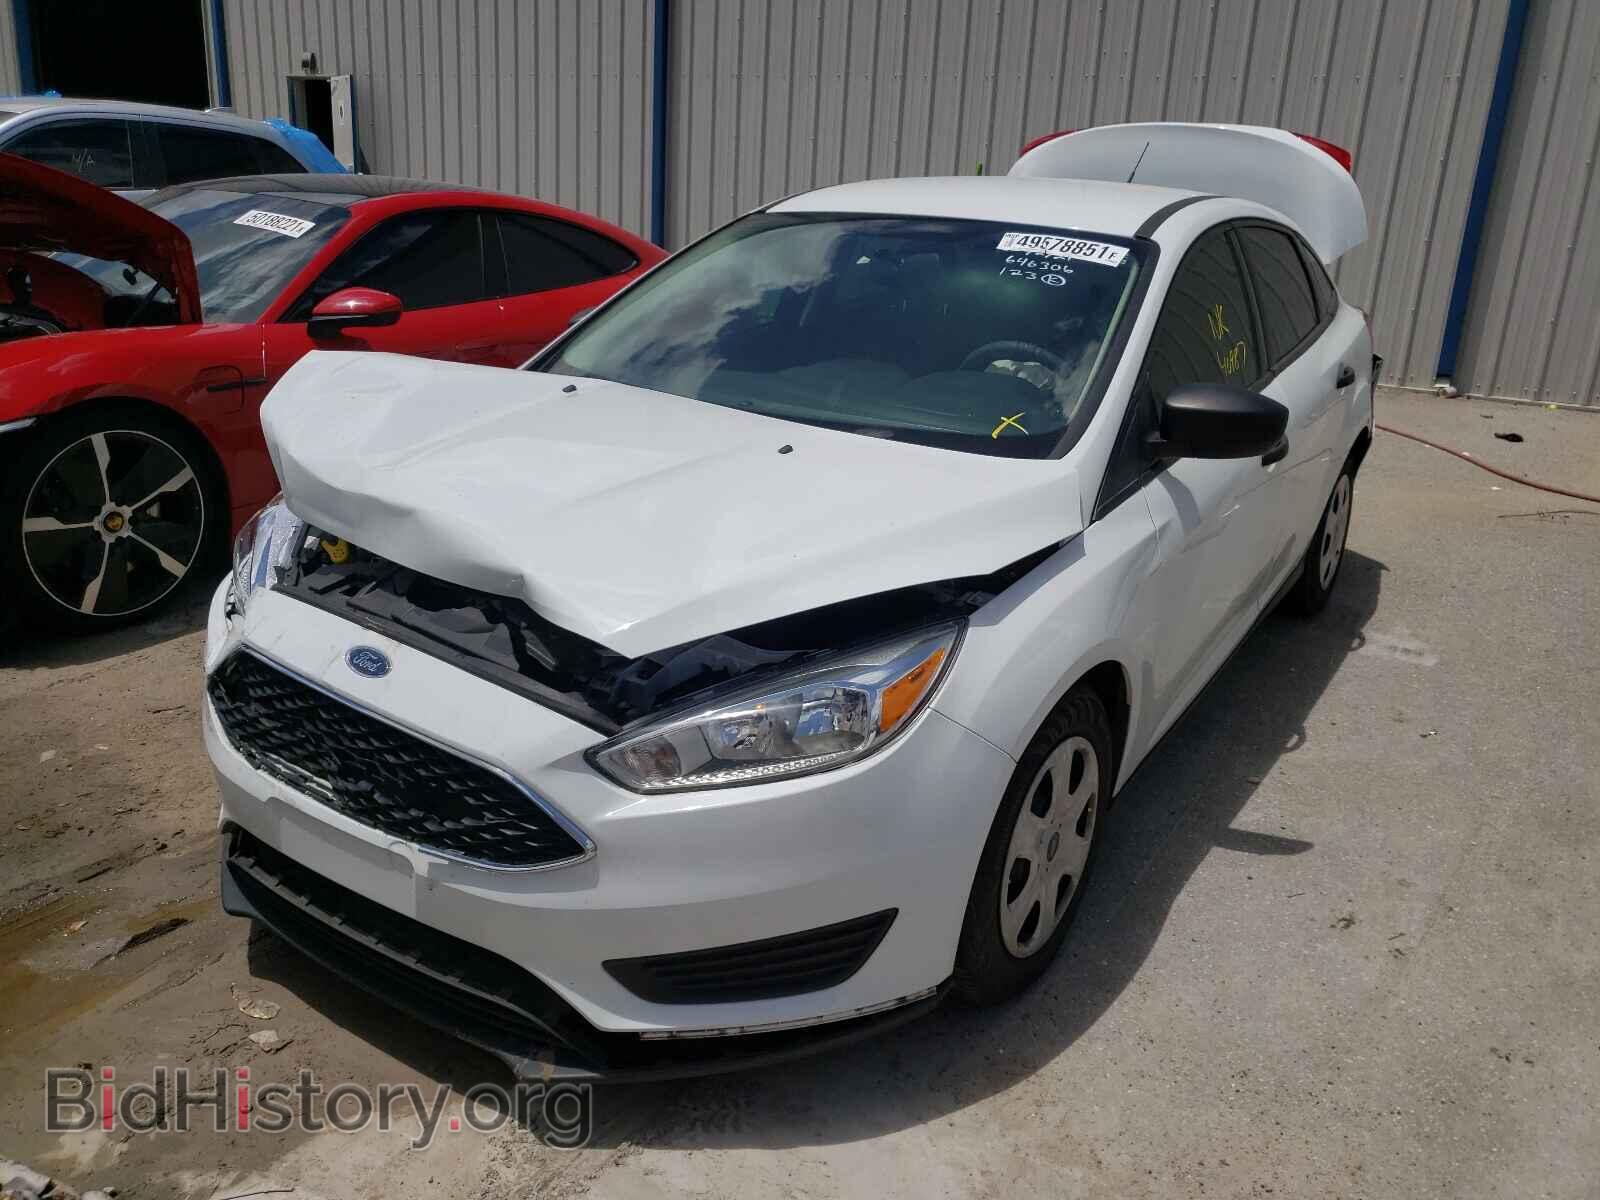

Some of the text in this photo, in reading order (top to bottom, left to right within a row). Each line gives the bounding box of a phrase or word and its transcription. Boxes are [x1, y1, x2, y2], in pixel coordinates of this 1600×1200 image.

[1016, 235, 1108, 259] 49578851
[999, 266, 1037, 280] 123
[1005, 255, 1074, 273] 646306
[353, 651, 383, 672] Ford
